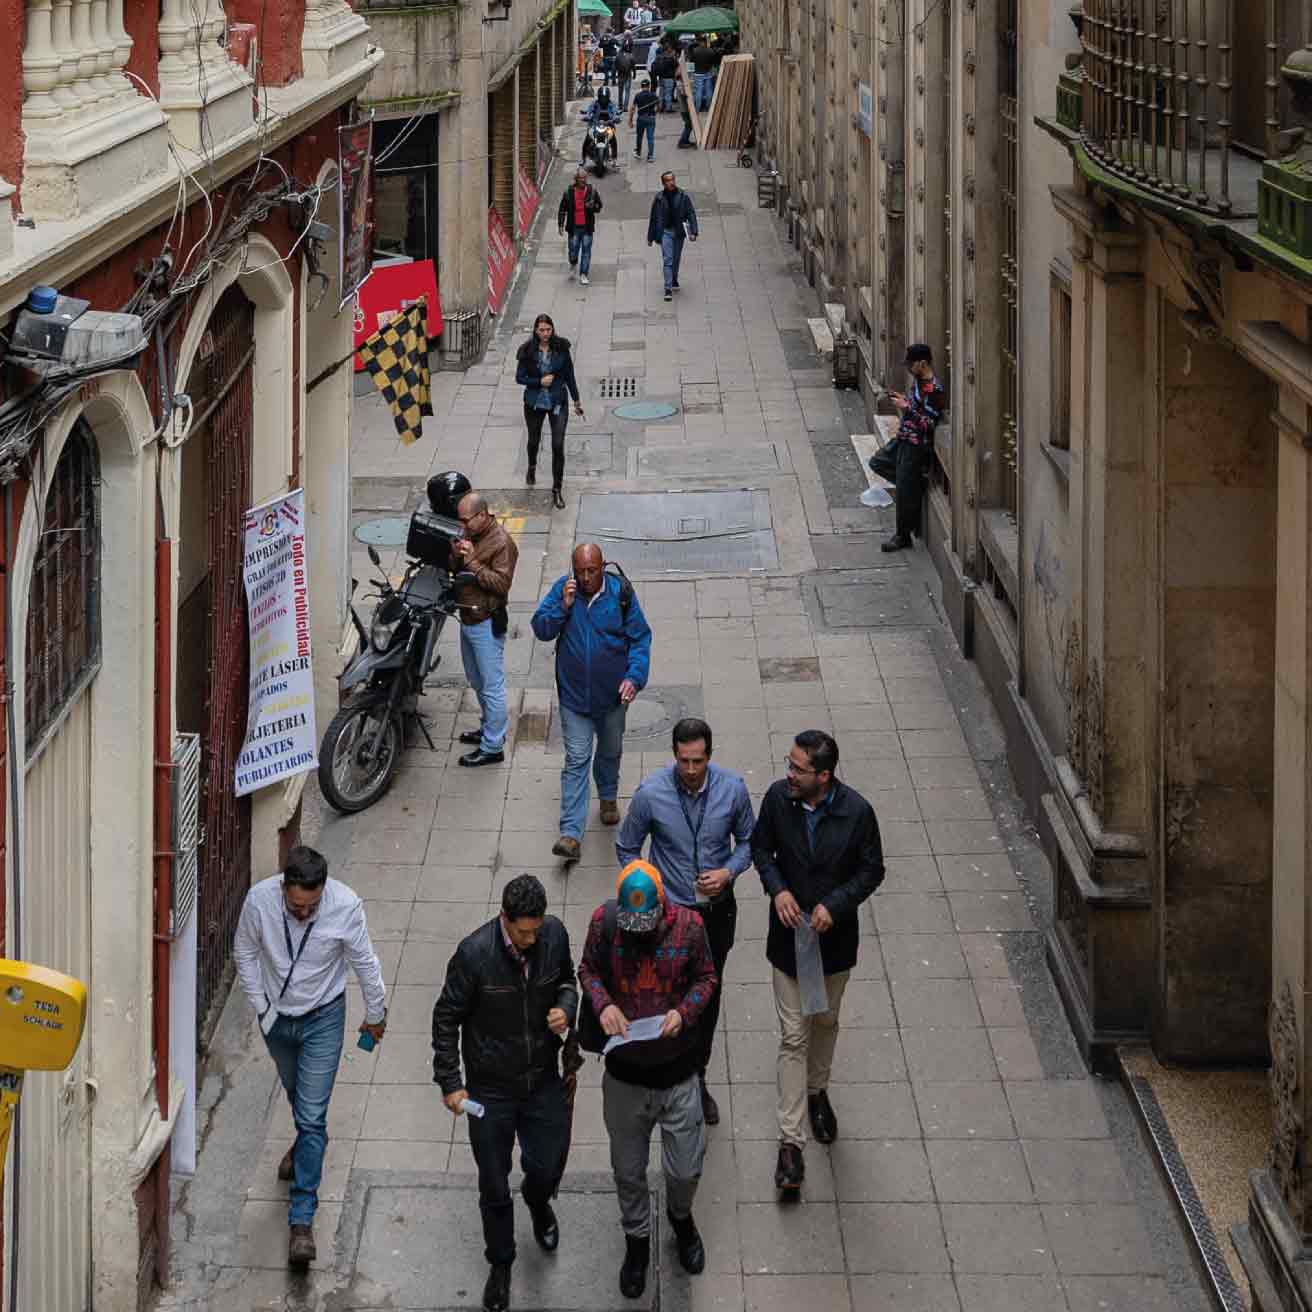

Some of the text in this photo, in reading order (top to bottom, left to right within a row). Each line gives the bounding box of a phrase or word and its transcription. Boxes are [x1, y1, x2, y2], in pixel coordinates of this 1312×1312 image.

[292, 535, 311, 657] Todo en Publicidad
[269, 655, 310, 679] LÁSER
[236, 749, 314, 788] PUBLICITARIOS
[33, 999, 61, 1016] TESA
